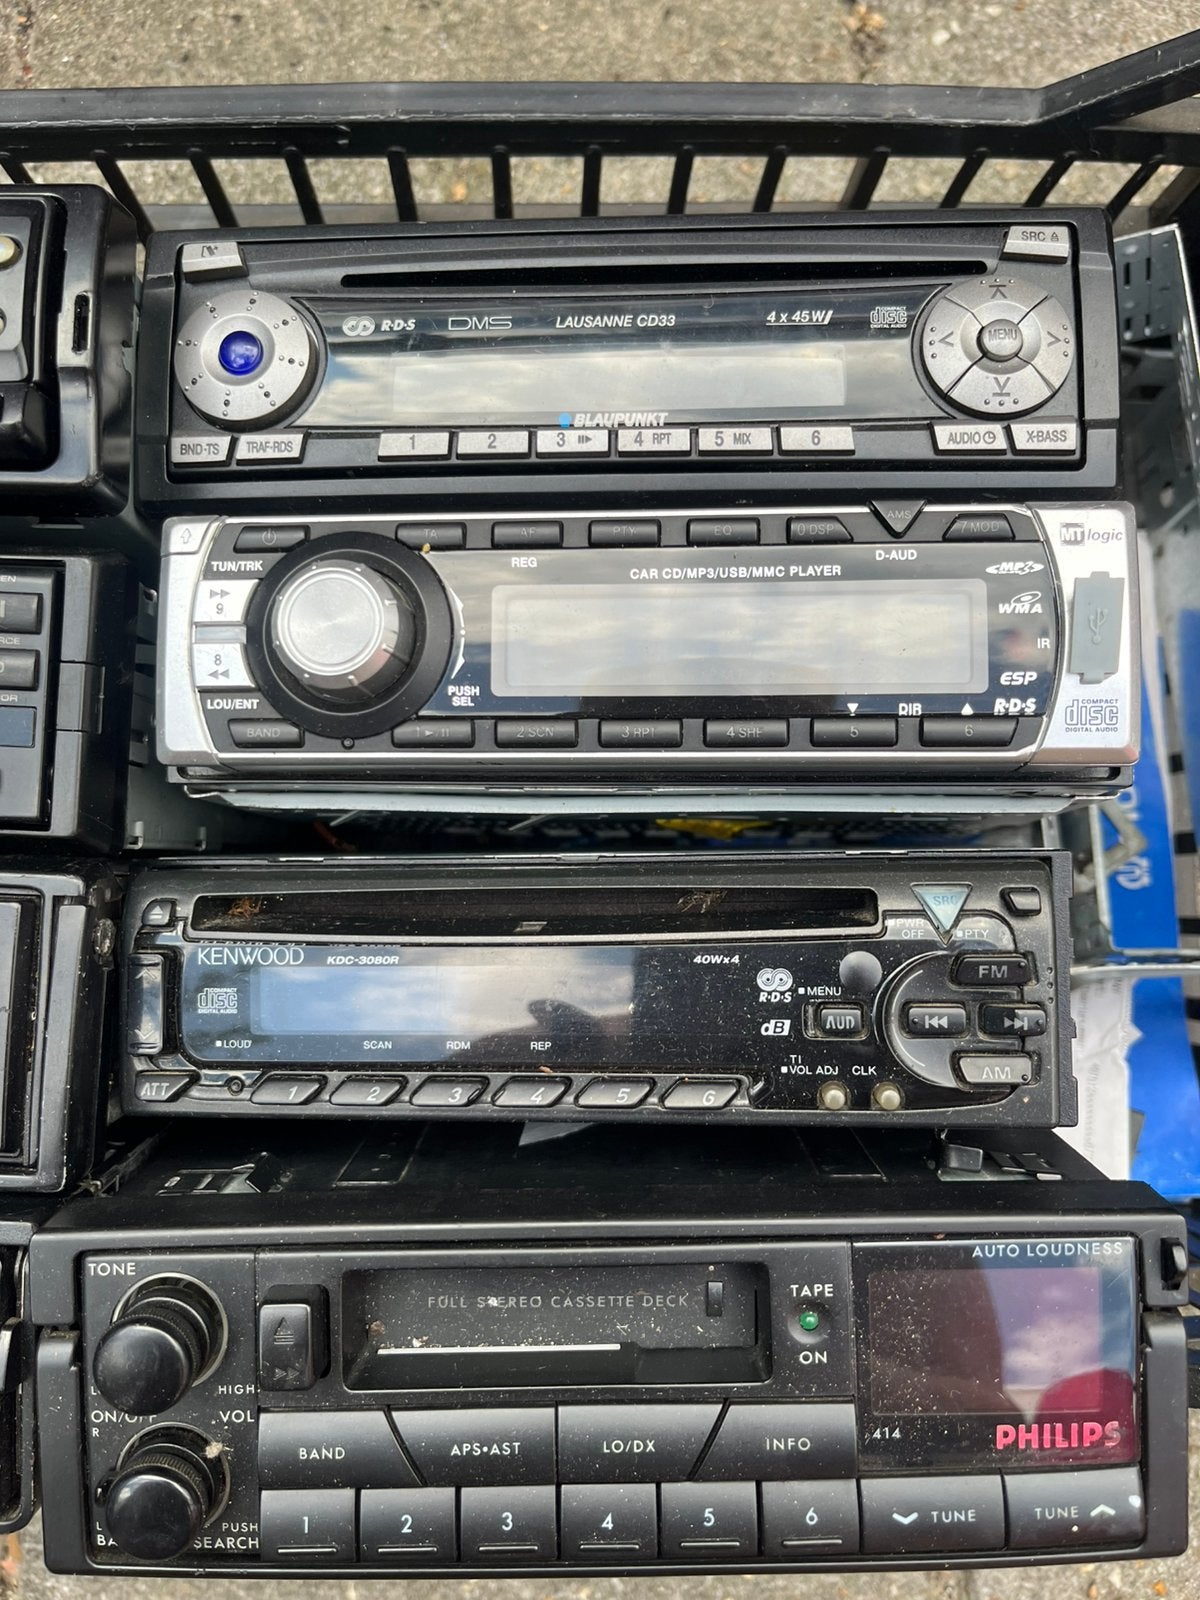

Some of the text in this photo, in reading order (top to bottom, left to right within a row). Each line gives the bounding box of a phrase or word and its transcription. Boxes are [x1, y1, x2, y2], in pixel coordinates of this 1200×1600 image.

[1021, 230, 1046, 241] SRC
[448, 316, 513, 331] DMS
[555, 314, 676, 329] LAUSANNE CD33
[988, 327, 1018, 342] MENU
[574, 411, 668, 427] BLAUPUNKT
[408, 434, 416, 450] 1
[487, 433, 497, 449] 2
[556, 432, 566, 447] 3
[633, 431, 672, 447] 4 RPT
[714, 431, 752, 447] 5 MIX
[810, 430, 821, 446] 6
[947, 431, 982, 444] AUDIO
[1026, 429, 1068, 443] X-BASS
[887, 510, 912, 519] AMS
[423, 528, 438, 539] TA
[520, 527, 537, 537] AF
[612, 526, 636, 537] PTY
[714, 525, 733, 536] EQ
[809, 524, 834, 535] DSP
[970, 521, 1000, 533] MOD
[875, 549, 918, 561] D-AUD
[210, 560, 264, 572] TUN/TRK
[511, 557, 538, 568] REG
[995, 561, 1037, 575] MP3
[629, 565, 842, 580] CAR CD/MP3/USB/MMC PLAYER
[216, 603, 223, 615] 9
[998, 602, 1043, 614] WMA
[1037, 638, 1051, 649] IR
[214, 654, 222, 666] 8
[1000, 671, 1038, 685] ESP
[447, 685, 480, 697] PUSH
[206, 698, 260, 710] LOU/ENT
[451, 697, 475, 707] SEL
[246, 727, 281, 738] BAND
[516, 726, 554, 738] 2 SCN
[621, 726, 630, 738] 3
[726, 726, 736, 738] 4
[849, 725, 859, 738] 5
[964, 724, 974, 737] 6
[933, 895, 958, 906] SRC
[895, 919, 925, 928] PWR
[901, 929, 925, 939] OFF
[964, 929, 990, 938] PTY
[197, 946, 305, 966] KENWOOD
[326, 955, 400, 965] KDC-3080R
[693, 954, 740, 965] 40Wx4
[978, 964, 1008, 979] FM
[807, 986, 842, 996] MENU
[760, 1019, 791, 1036] dB
[825, 1015, 856, 1030] AUD
[223, 1039, 251, 1049] LOUD
[363, 1040, 392, 1050] SCAN
[446, 1041, 471, 1050] RDM
[530, 1041, 552, 1051] REP
[789, 1054, 802, 1064] TI
[790, 1065, 839, 1075] VOL ADJ
[851, 1065, 877, 1076] CLK
[982, 1066, 1011, 1080] AM
[140, 1082, 170, 1097] ATT
[288, 1085, 299, 1101] 1
[366, 1086, 381, 1102] 2
[448, 1086, 463, 1103] 3
[530, 1087, 546, 1104] 4
[616, 1087, 631, 1104] 5
[702, 1089, 717, 1106] 6
[972, 1241, 1123, 1258] AUTO LOUDNESS
[88, 1262, 136, 1277] TONE
[790, 1283, 834, 1297] TAPE
[428, 1296, 468, 1308] FULL
[551, 1295, 635, 1308] CASSETTE
[642, 1294, 690, 1308] DECK
[799, 1350, 828, 1364] ON
[218, 1384, 255, 1395] HIGH
[219, 1409, 255, 1423] VOL
[92, 1427, 100, 1438] R
[872, 1426, 901, 1440] 414
[995, 1420, 1122, 1450] PHILIPS
[603, 1439, 656, 1454] LO/DX
[765, 1437, 811, 1452] INFO
[299, 1446, 346, 1460] BAND
[702, 1508, 715, 1527] 5
[805, 1506, 819, 1525] 6
[931, 1509, 977, 1523] TUNE
[1034, 1505, 1079, 1520] TUNE
[222, 1522, 259, 1532] PUSH
[302, 1515, 310, 1534] 1
[400, 1514, 413, 1533] 2
[501, 1512, 514, 1531] 3
[600, 1512, 614, 1530] 4
[193, 1536, 260, 1549] SEARCH
